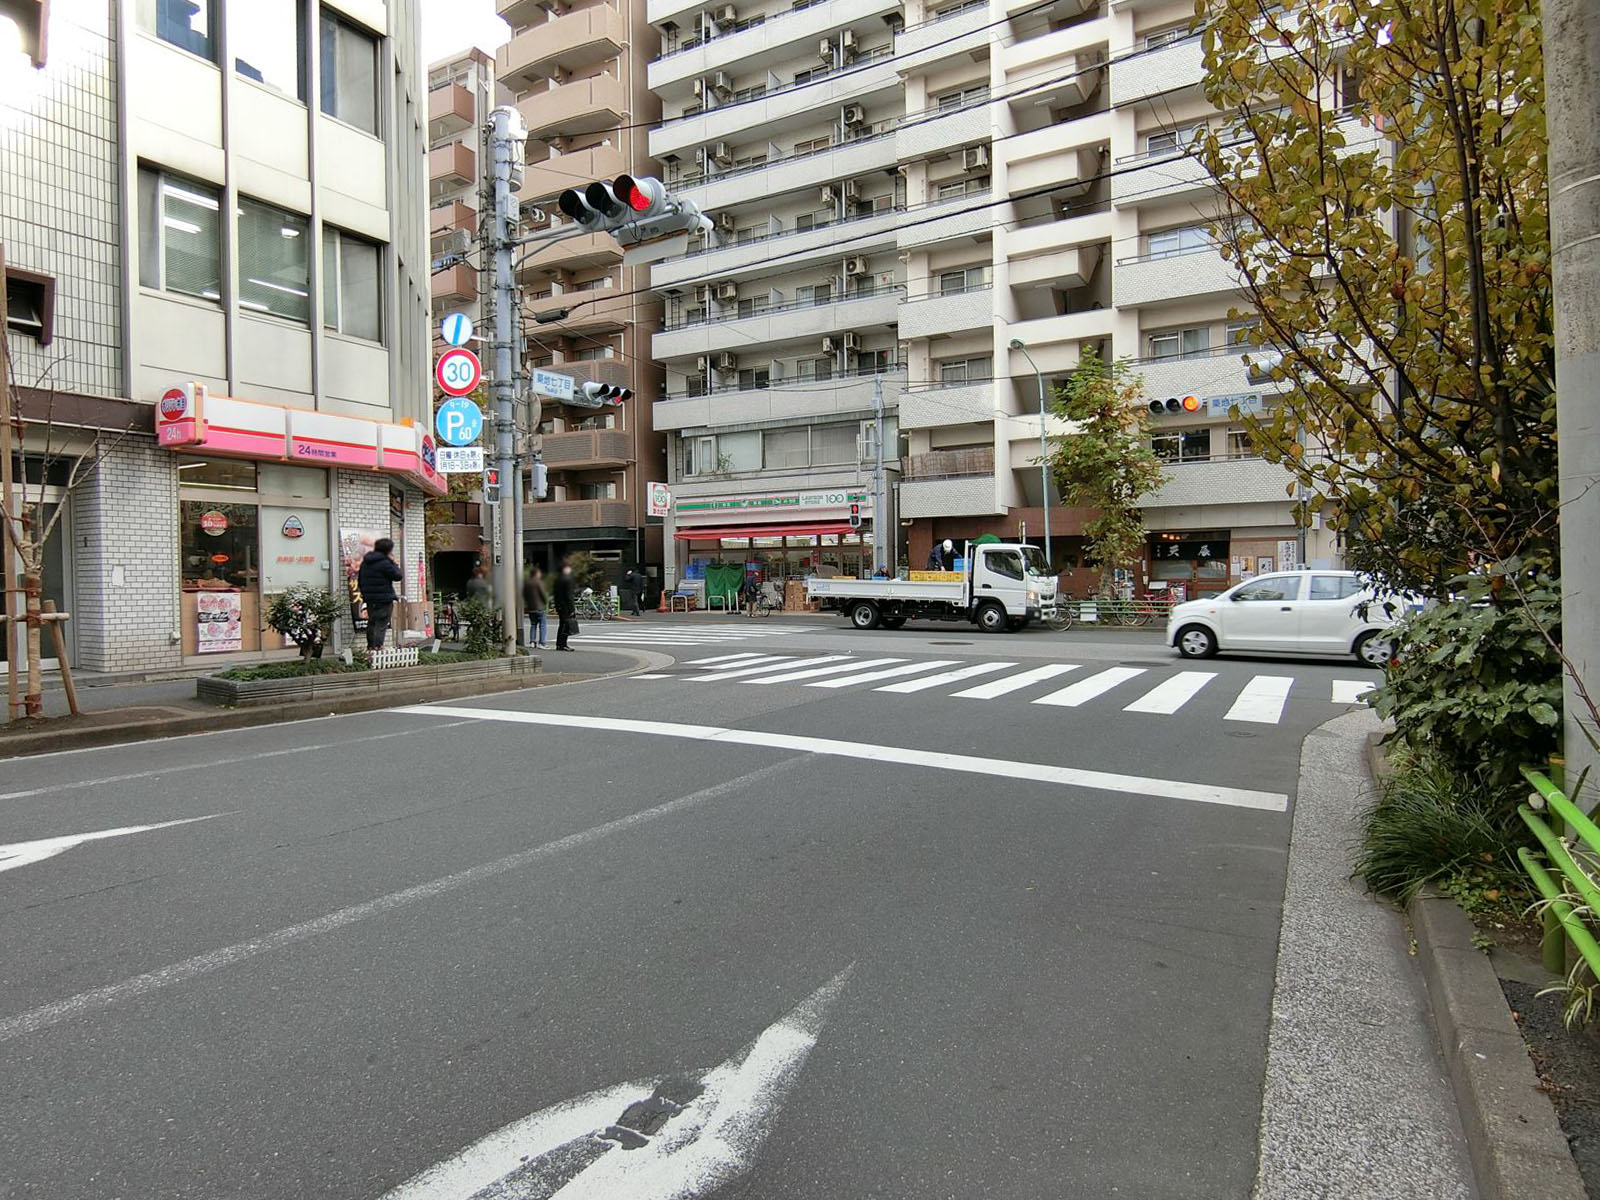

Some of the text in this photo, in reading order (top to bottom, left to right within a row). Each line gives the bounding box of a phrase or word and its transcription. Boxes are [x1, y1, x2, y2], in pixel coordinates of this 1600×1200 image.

[447, 362, 471, 382] 30
[537, 372, 571, 390] 築地七丁目
[166, 426, 182, 441] 24h
[447, 411, 464, 440] P
[298, 444, 337, 458] 24時間営業
[825, 493, 845, 504] 100
